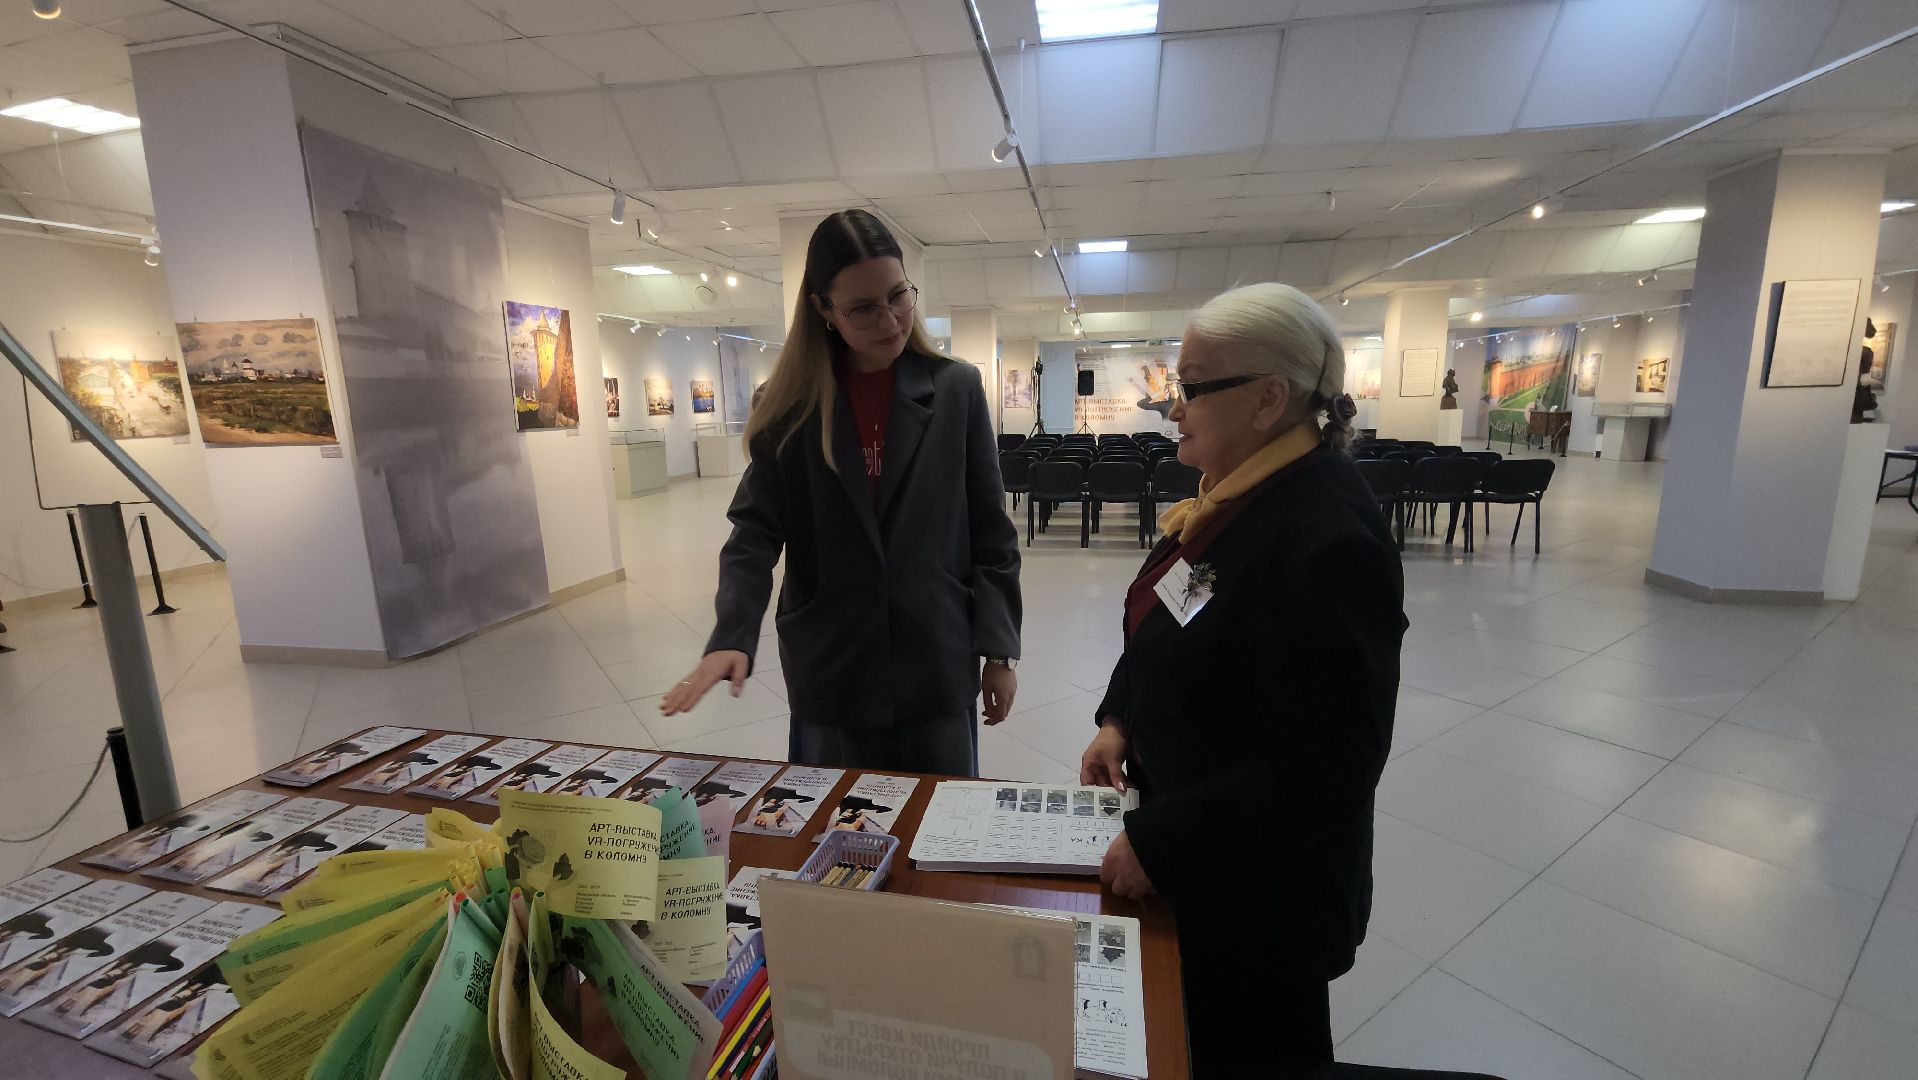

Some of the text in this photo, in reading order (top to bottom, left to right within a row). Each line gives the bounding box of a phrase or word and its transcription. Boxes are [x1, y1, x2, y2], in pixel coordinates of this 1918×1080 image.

[584, 849, 593, 859] В
[597, 850, 647, 864] КОЛОМНУ
[660, 907, 711, 921] В КОЛОМНУ
